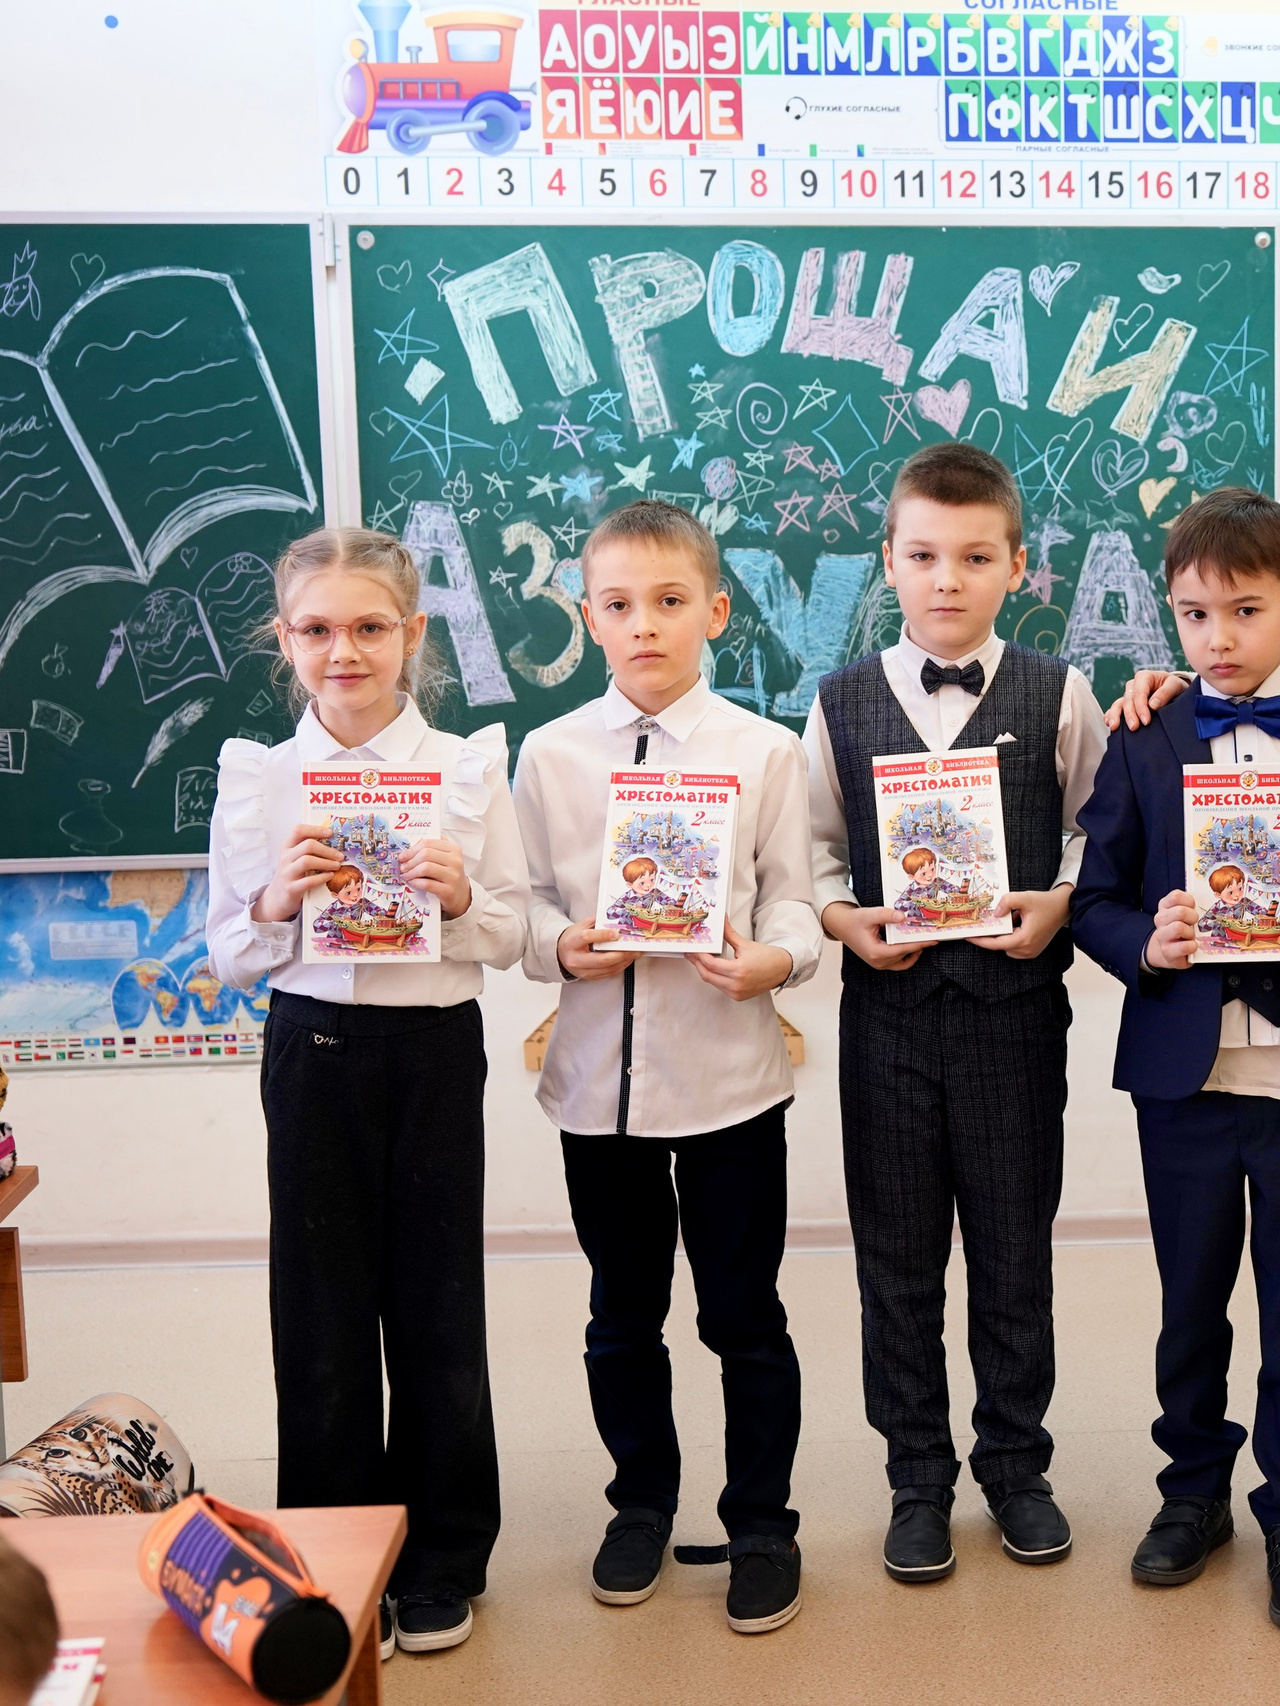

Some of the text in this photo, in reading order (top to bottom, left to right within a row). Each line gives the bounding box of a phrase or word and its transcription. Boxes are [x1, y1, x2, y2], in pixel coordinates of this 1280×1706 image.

[543, 12, 1175, 77] А О У Ы Э Й Н М Л Р Б В Г Д Ж З
[543, 78, 738, 135] Я Ё Ю И Е
[948, 93, 979, 138] П
[986, 93, 1021, 138] Ф
[1030, 94, 1060, 138] К
[1067, 94, 1098, 138] Т
[1104, 94, 1139, 138] Ш
[1143, 94, 1174, 139] С
[1184, 95, 1215, 139] Х
[1222, 95, 1255, 143] Ц
[344, 167, 360, 194] 0
[398, 168, 409, 194] 1
[447, 168, 463, 195] 2
[498, 168, 514, 195] 3
[548, 169, 565, 195] 4
[600, 169, 616, 195] 5
[650, 169, 666, 196] 6
[700, 170, 716, 196] 7
[752, 170, 767, 196] 8
[801, 170, 817, 197] 9
[842, 170, 876, 197] 10
[895, 171, 923, 197] 11
[941, 171, 975, 197] 12
[991, 171, 1025, 198] 13
[1040, 171, 1074, 197] 14
[1089, 171, 1123, 198] 15
[1138, 172, 1172, 198] 16
[1187, 172, 1220, 198] 17
[1236, 172, 1269, 198] 18
[442, 239, 1198, 443] ПРОЩАЙ
[402, 500, 1177, 719] АЗУА
[946, 759, 989, 768] БИБЛИОТЕКА
[616, 790, 729, 803] ХРЕСТОМАТИЯ
[881, 774, 992, 794] ХРЕСТОМАТИЯ
[310, 791, 432, 804] ХРЕСТОМАТИЯ
[960, 795, 994, 811] 2 класс
[394, 812, 431, 829] 2 класс
[690, 811, 706, 826] 2
[146, 1451, 174, 1483] ONE
